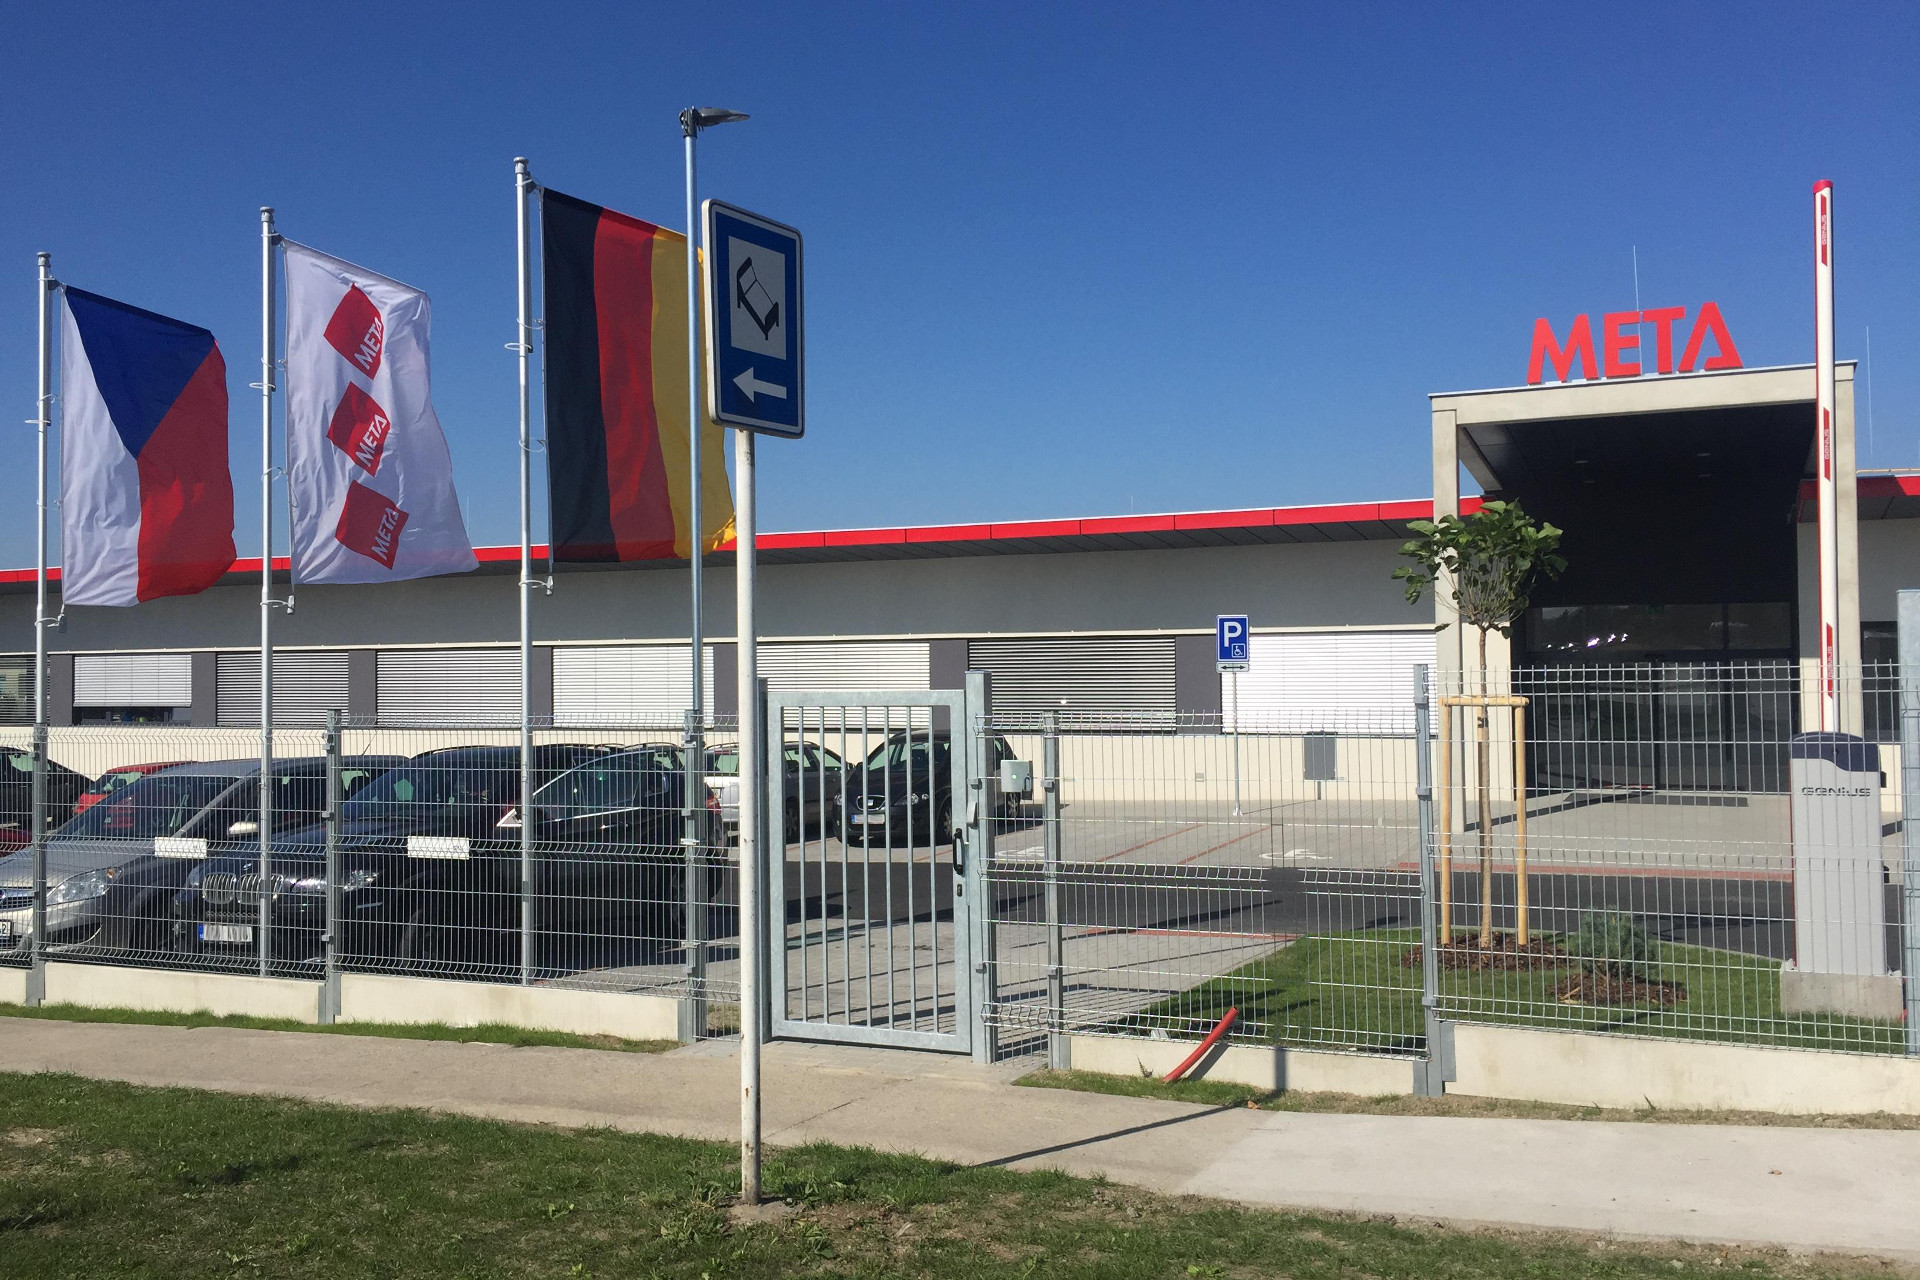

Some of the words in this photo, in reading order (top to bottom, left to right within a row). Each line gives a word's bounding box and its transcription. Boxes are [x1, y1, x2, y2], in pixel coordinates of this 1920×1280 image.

[354, 316, 382, 370] META
[1526, 301, 1744, 385] META
[355, 414, 388, 467] META
[371, 507, 399, 561] META
[1223, 621, 1242, 647] P
